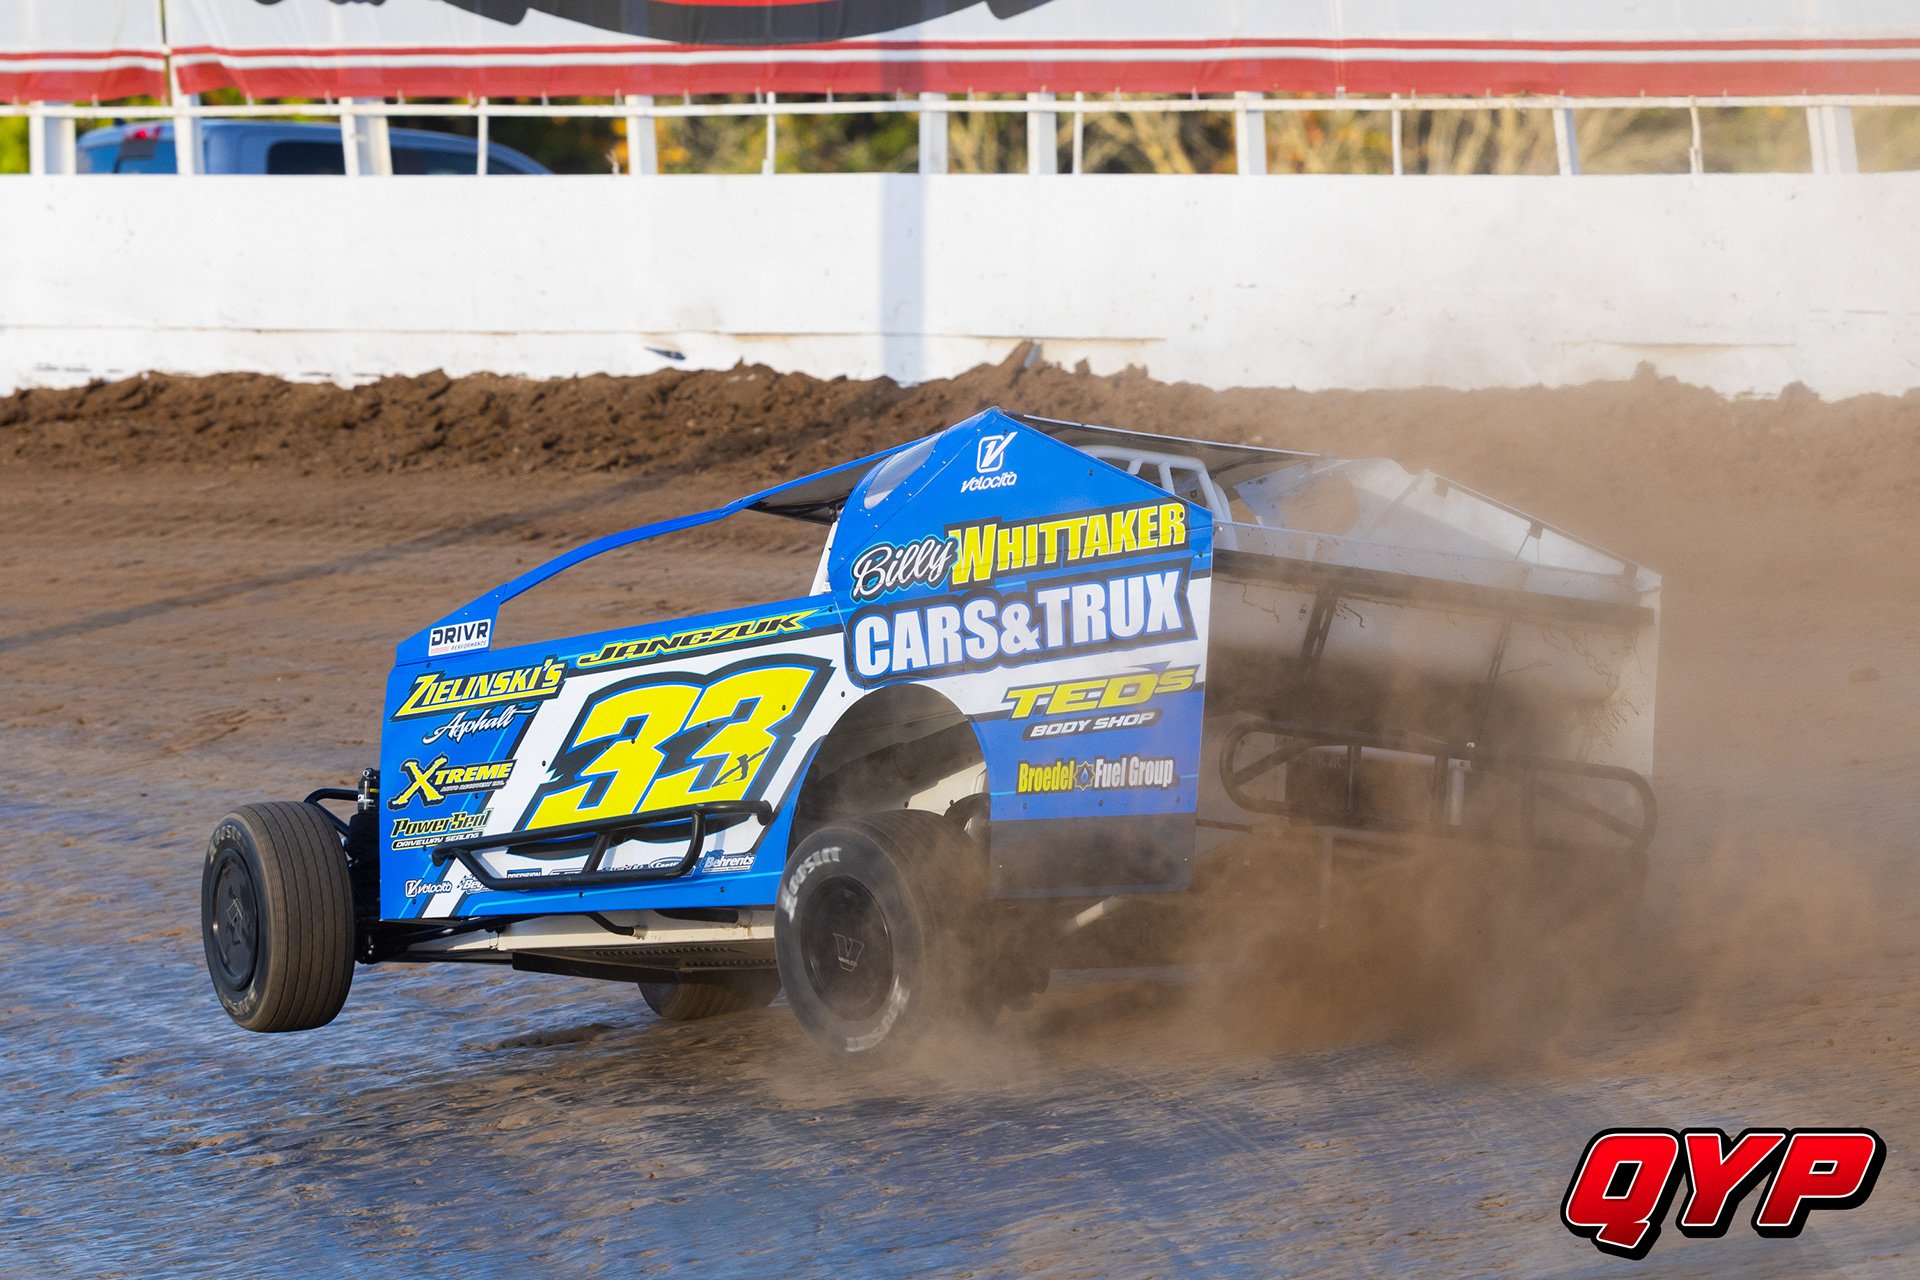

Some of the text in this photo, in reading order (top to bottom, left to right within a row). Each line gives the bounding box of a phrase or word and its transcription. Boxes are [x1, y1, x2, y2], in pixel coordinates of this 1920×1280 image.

[852, 501, 1187, 598] Billy WHITTAKER
[431, 621, 489, 647] DRIVR
[580, 612, 806, 665] JANCZUK
[853, 570, 1187, 678] CARS&TRUX
[450, 640, 488, 651] PERFORMANCE
[394, 658, 565, 717] ZIELINSKI'S
[421, 704, 539, 745] Asphalt
[1029, 711, 1155, 738] BODY SHOP
[522, 664, 820, 832] 33
[391, 756, 514, 805] XTREME
[1018, 755, 1175, 793] Broedel Fuel Group
[395, 831, 480, 849] DRIVEWAY SEALING
[703, 855, 755, 869] Behrents
[463, 879, 485, 891] Bey
